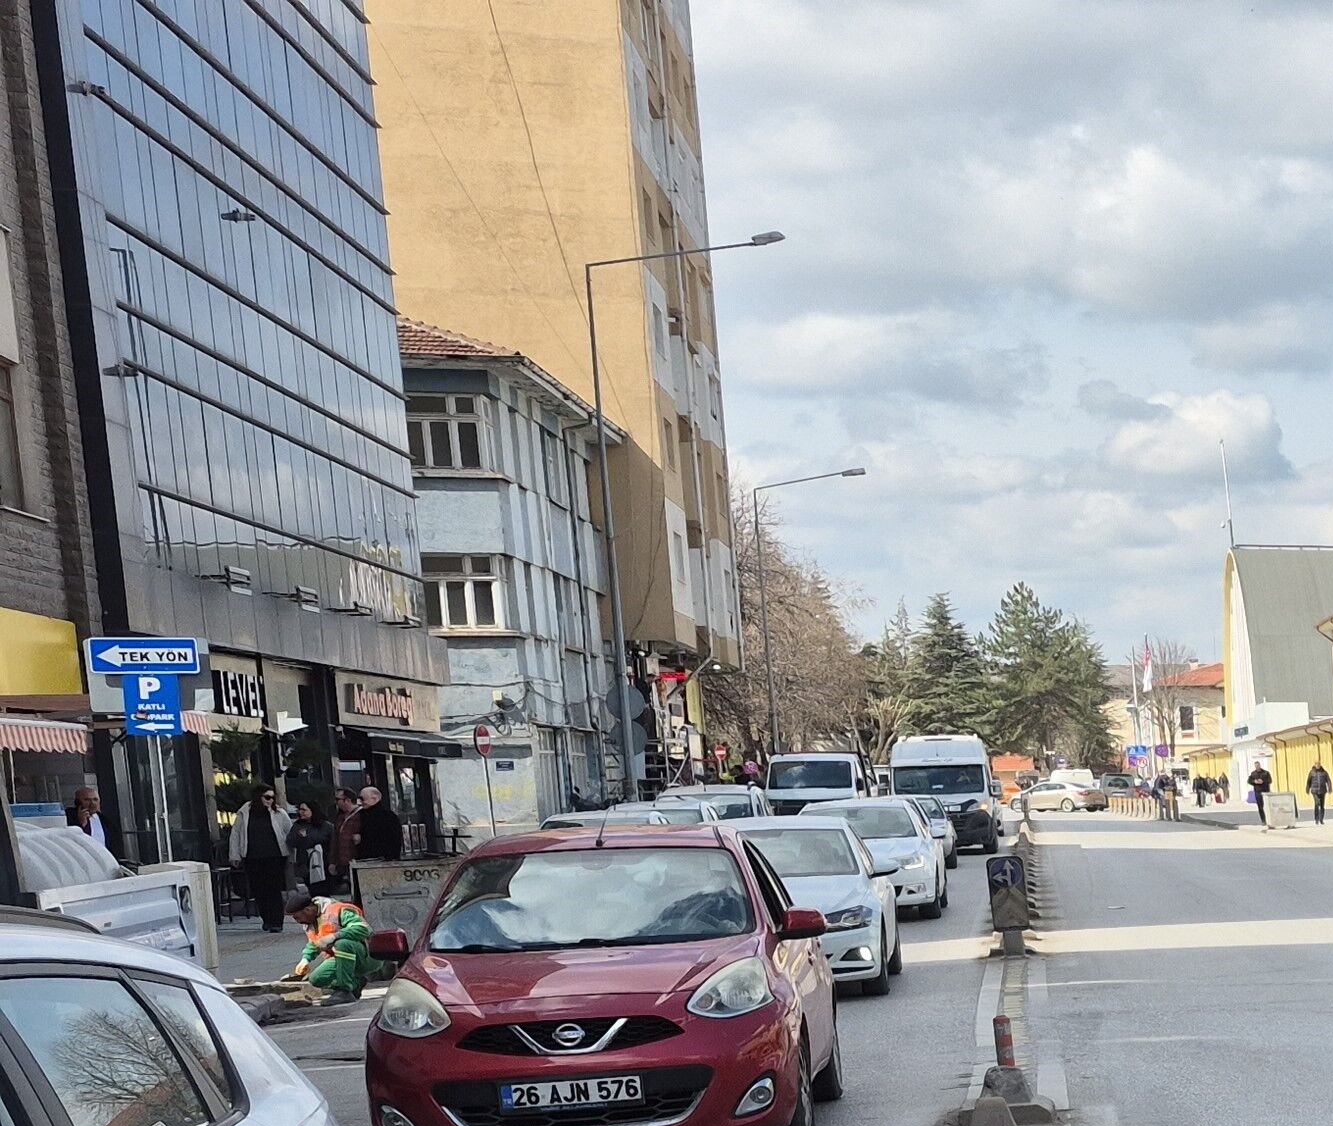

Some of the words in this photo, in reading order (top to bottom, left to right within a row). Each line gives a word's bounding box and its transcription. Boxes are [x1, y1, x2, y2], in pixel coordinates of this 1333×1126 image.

[118, 651, 150, 662] TEK
[155, 649, 188, 662] YÖN
[138, 677, 161, 699] P
[354, 683, 387, 716] Adana
[512, 1086, 540, 1107] 26
[550, 1082, 590, 1104] AJN
[597, 1078, 638, 1100] 576
